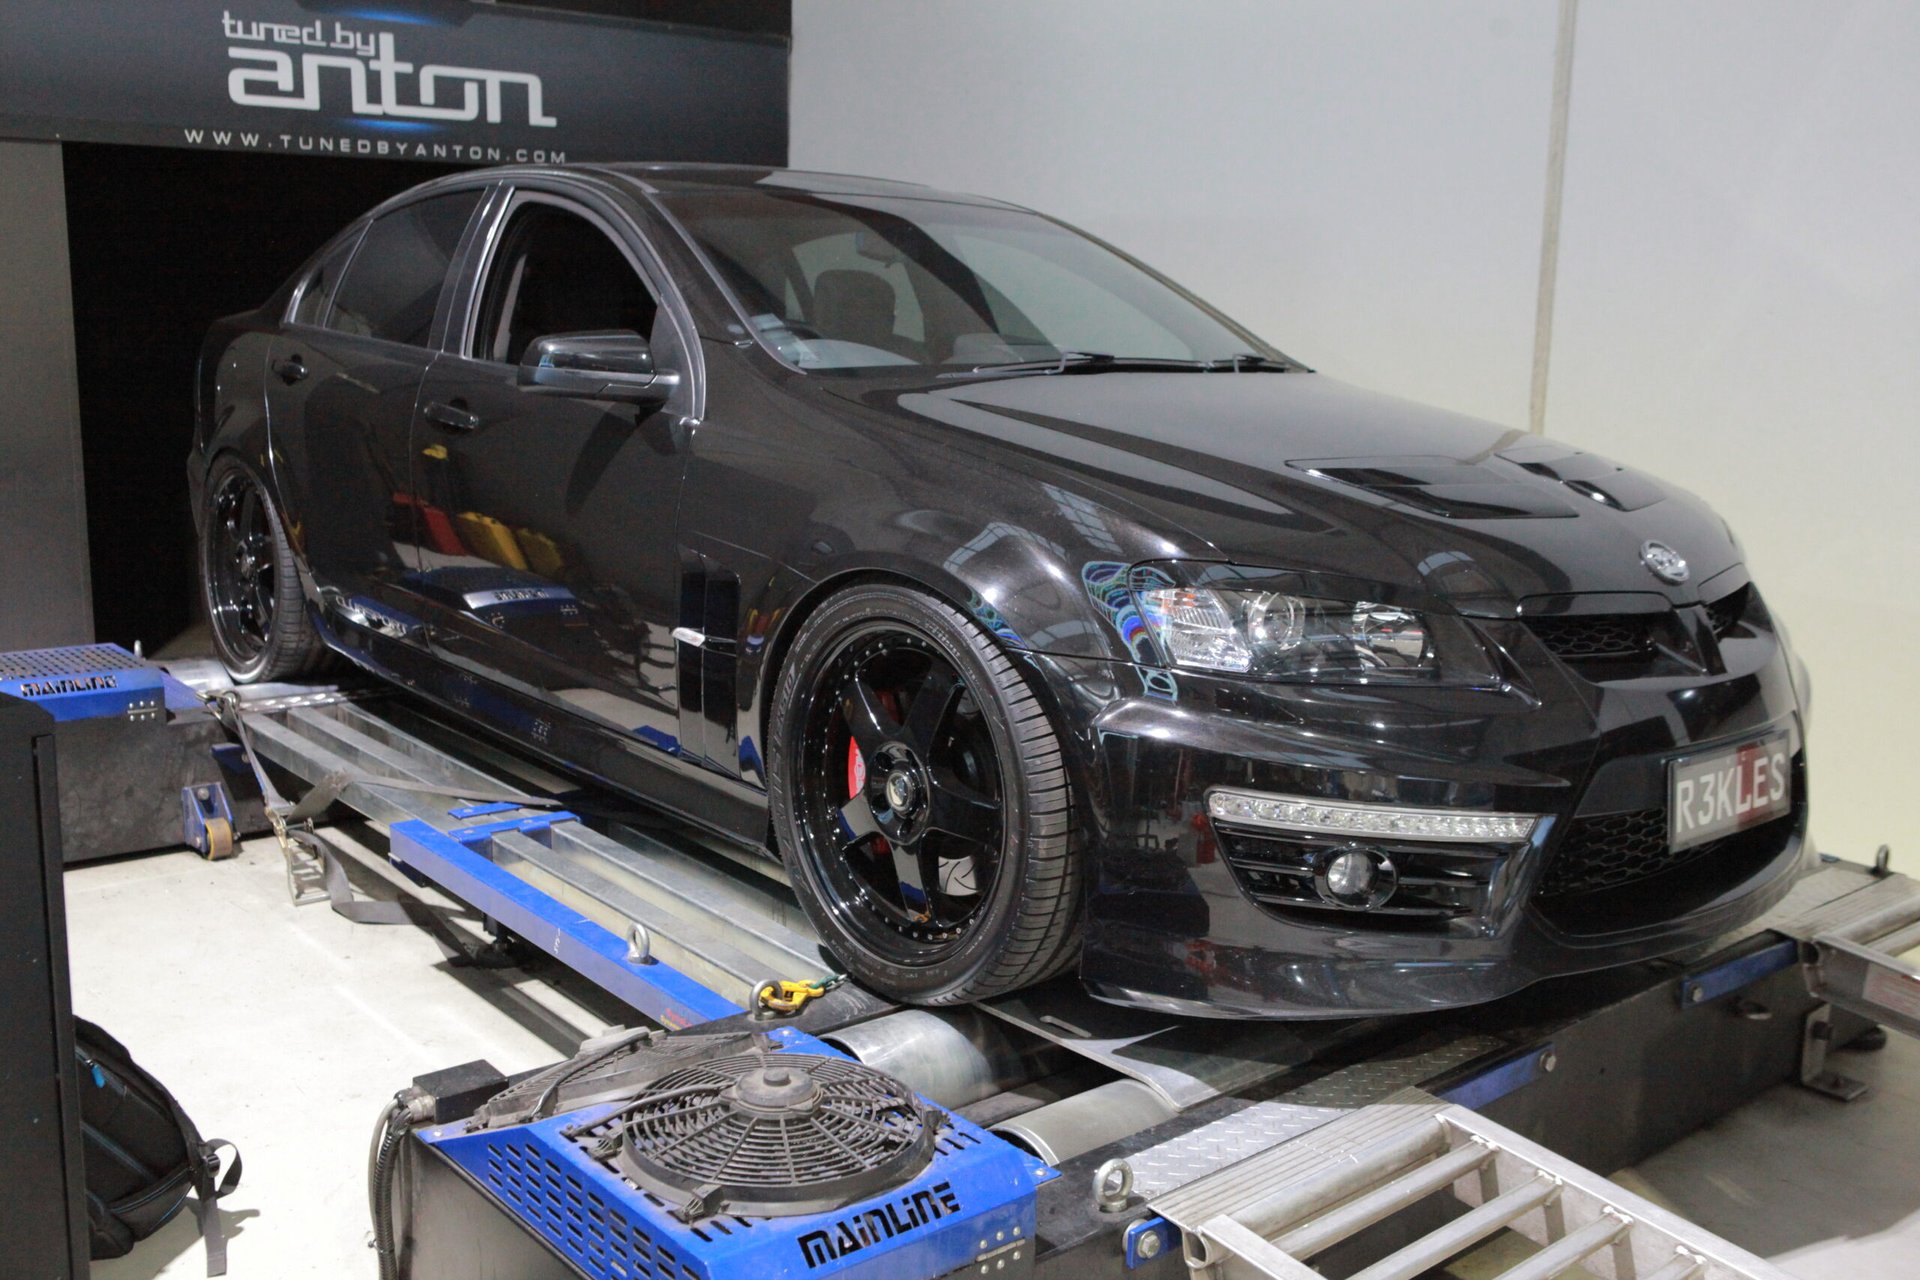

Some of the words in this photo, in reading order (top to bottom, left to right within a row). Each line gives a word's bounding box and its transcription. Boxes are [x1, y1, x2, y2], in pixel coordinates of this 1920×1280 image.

[222, 10, 326, 47] tuned
[330, 21, 376, 57] by
[228, 32, 557, 127] anton
[184, 129, 566, 165] WWW.TUNEDBYANTON.COM
[1676, 753, 1785, 833] R3KLES
